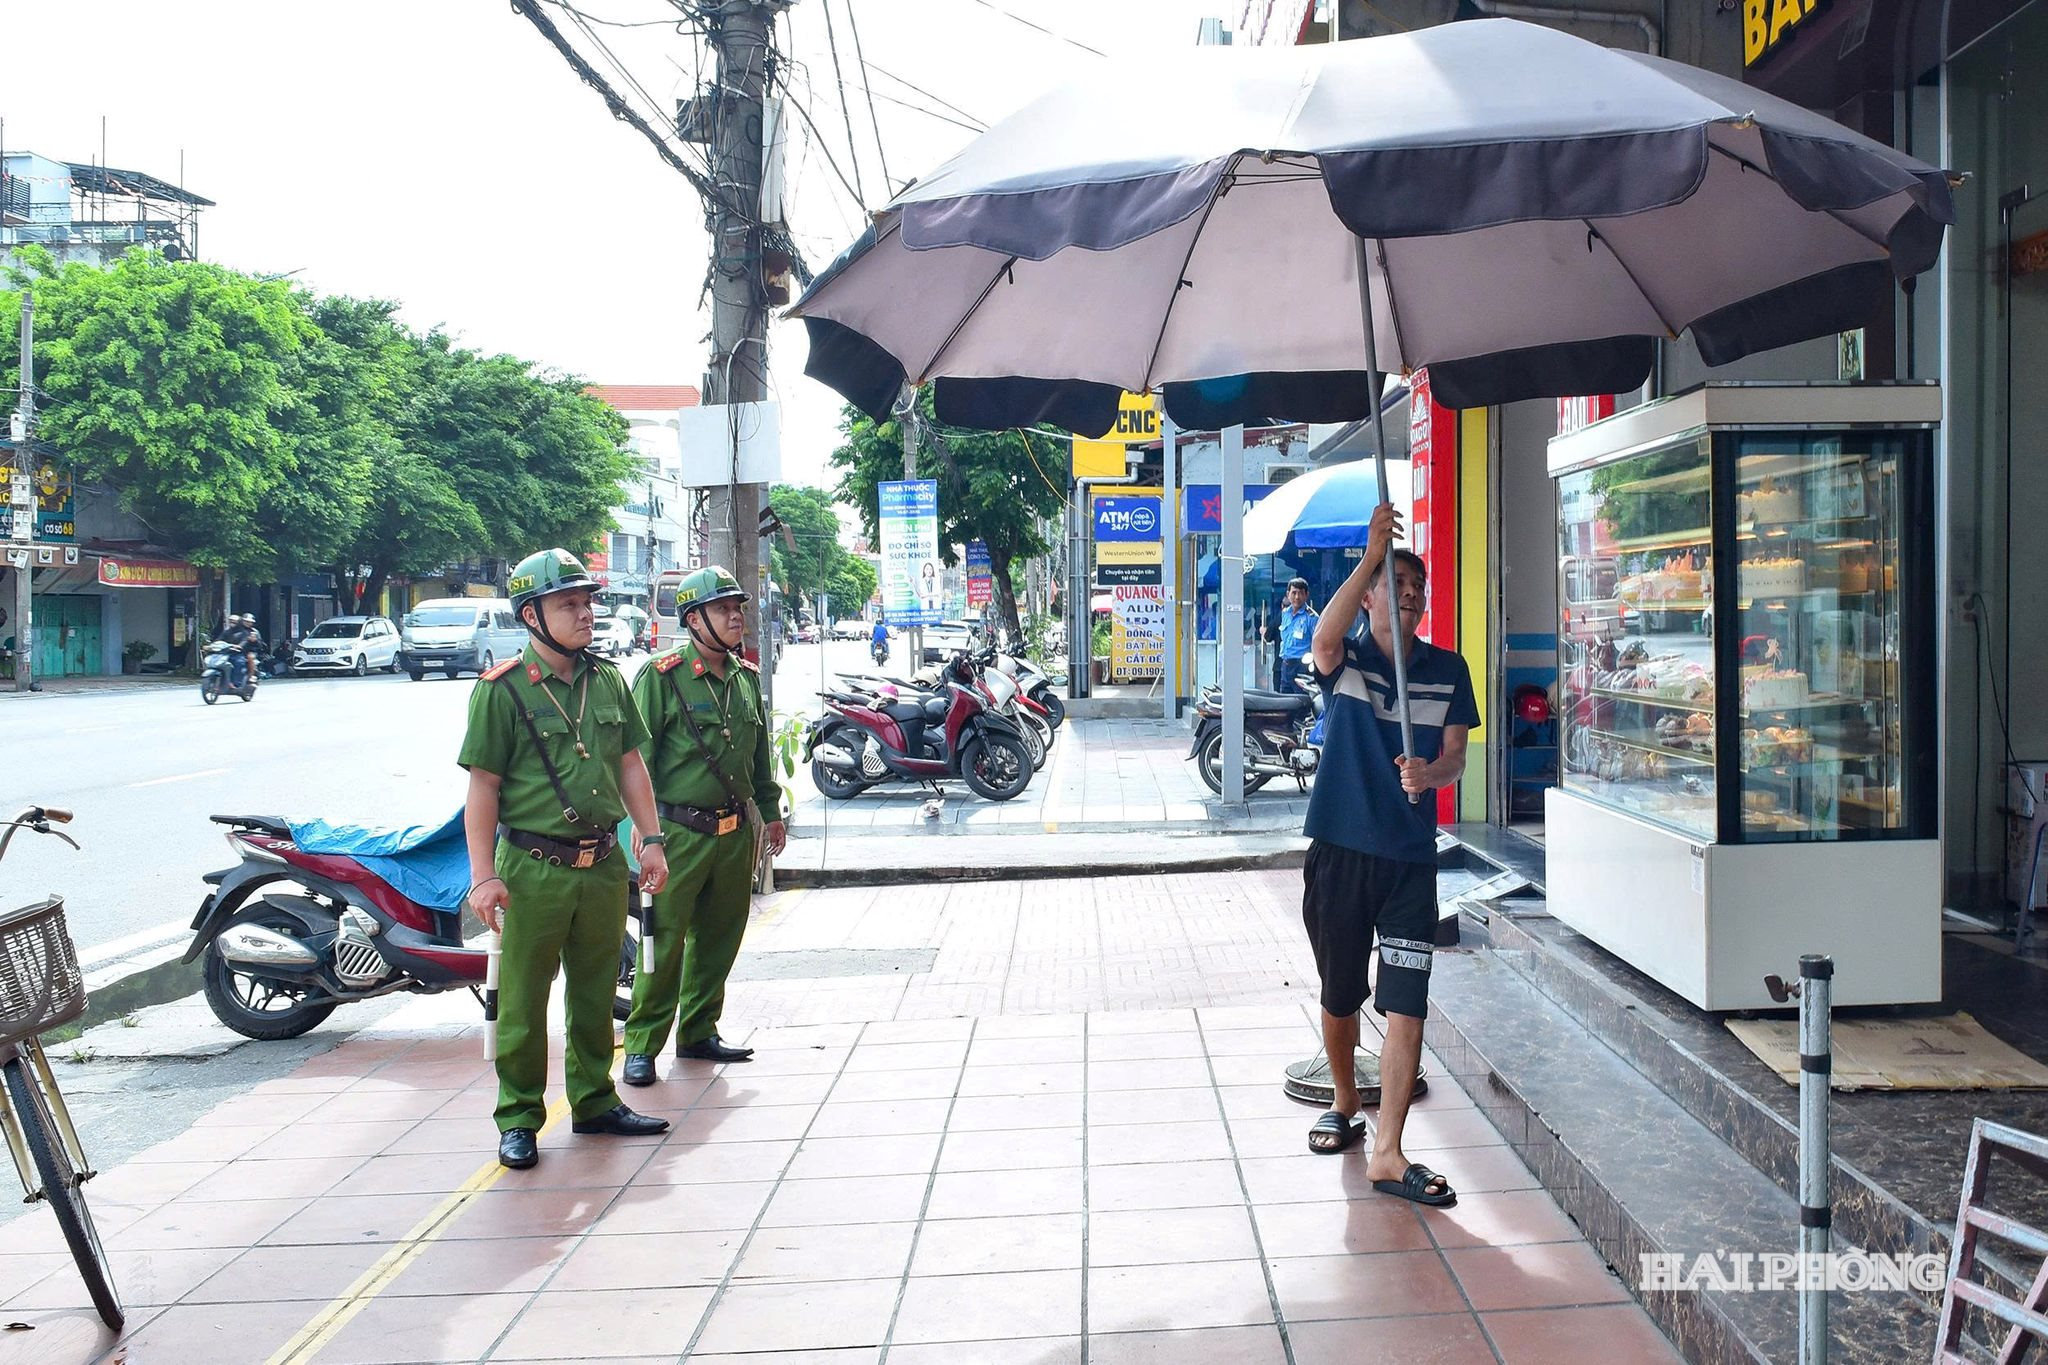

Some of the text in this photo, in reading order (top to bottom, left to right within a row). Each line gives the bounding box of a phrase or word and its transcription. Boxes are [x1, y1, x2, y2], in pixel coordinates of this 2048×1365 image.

[1743, 0, 1817, 67] BA
[1116, 410, 1155, 433] CNC
[903, 483, 930, 492] THUỐC
[882, 492, 935, 502] Pharmacity
[1099, 511, 1130, 524] ATM
[63, 522, 73, 535] 68
[1111, 523, 1130, 531] 24/7
[509, 574, 535, 592] CSTT
[676, 588, 698, 605] CSTT
[1126, 617, 1150, 625] LED
